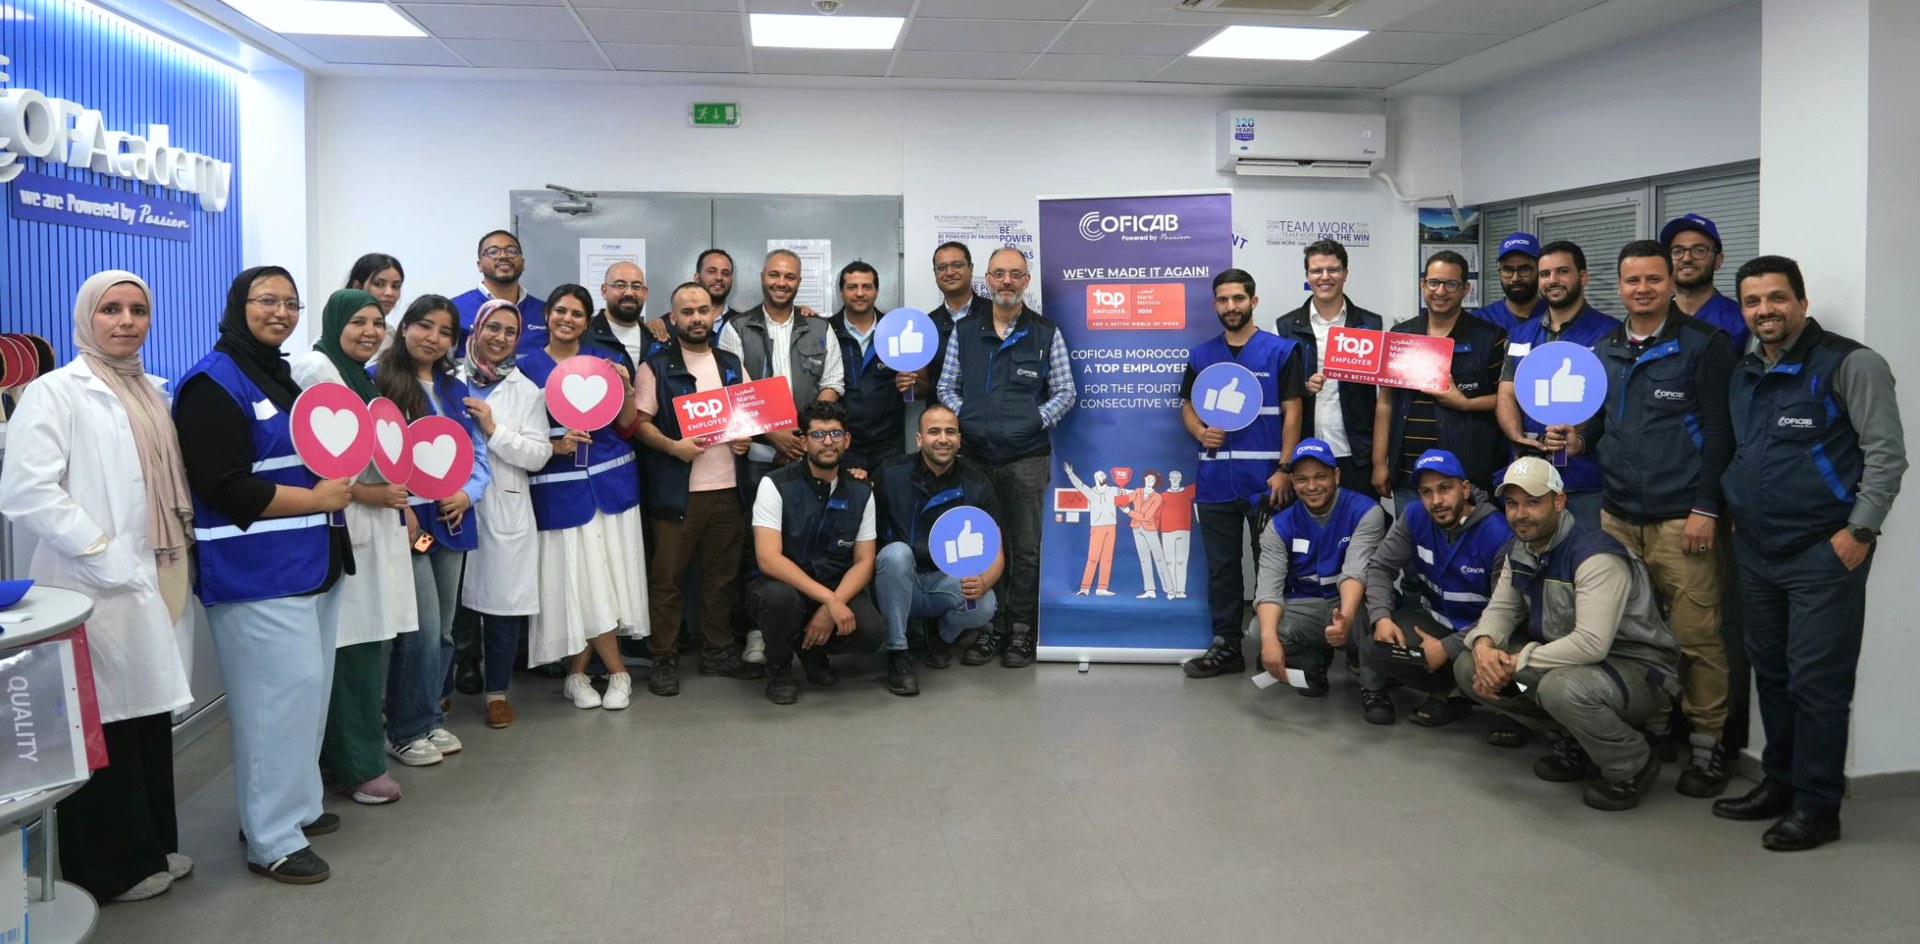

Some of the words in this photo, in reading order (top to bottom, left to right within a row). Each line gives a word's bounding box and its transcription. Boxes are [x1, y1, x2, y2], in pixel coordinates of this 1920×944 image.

[1235, 117, 1255, 127] 120
[0, 55, 232, 212] OFAcademy
[20, 189, 41, 206] we
[42, 192, 64, 210] are
[67, 193, 119, 219] Powered
[119, 202, 136, 225] by
[138, 204, 190, 229] Passion
[999, 226, 1010, 234] BE
[1079, 211, 1179, 241] COFICAB
[1280, 220, 1314, 232] TEAM
[1318, 221, 1355, 233] WORK
[999, 234, 1033, 242] POWER
[1336, 233, 1351, 241] THE
[1063, 268, 1104, 278] WE'VE
[1108, 267, 1146, 277] MADE
[1150, 267, 1161, 277] IT
[1164, 266, 1209, 277] AGAIN!
[1092, 289, 1125, 308] top
[1334, 332, 1374, 357] top
[1071, 349, 1122, 360] COFICAB
[1125, 349, 1190, 359] MOROCCO
[1331, 356, 1372, 366] EMPLOYER
[1084, 365, 1092, 373] A
[1095, 364, 1119, 373] TOP
[1351, 374, 1375, 382] BETTER
[1377, 377, 1403, 385] WORLD
[1085, 384, 1108, 394] FOR
[1111, 383, 1134, 393] THE
[736, 394, 757, 402] Maroc
[738, 399, 765, 408] Morocco
[1080, 398, 1161, 408] CONSECUTIVE
[1165, 398, 1185, 407] YEA
[682, 398, 723, 420] top
[687, 417, 728, 431] EMPLOYER
[774, 418, 793, 426] WORK
[7, 676, 38, 762] QUALITY
